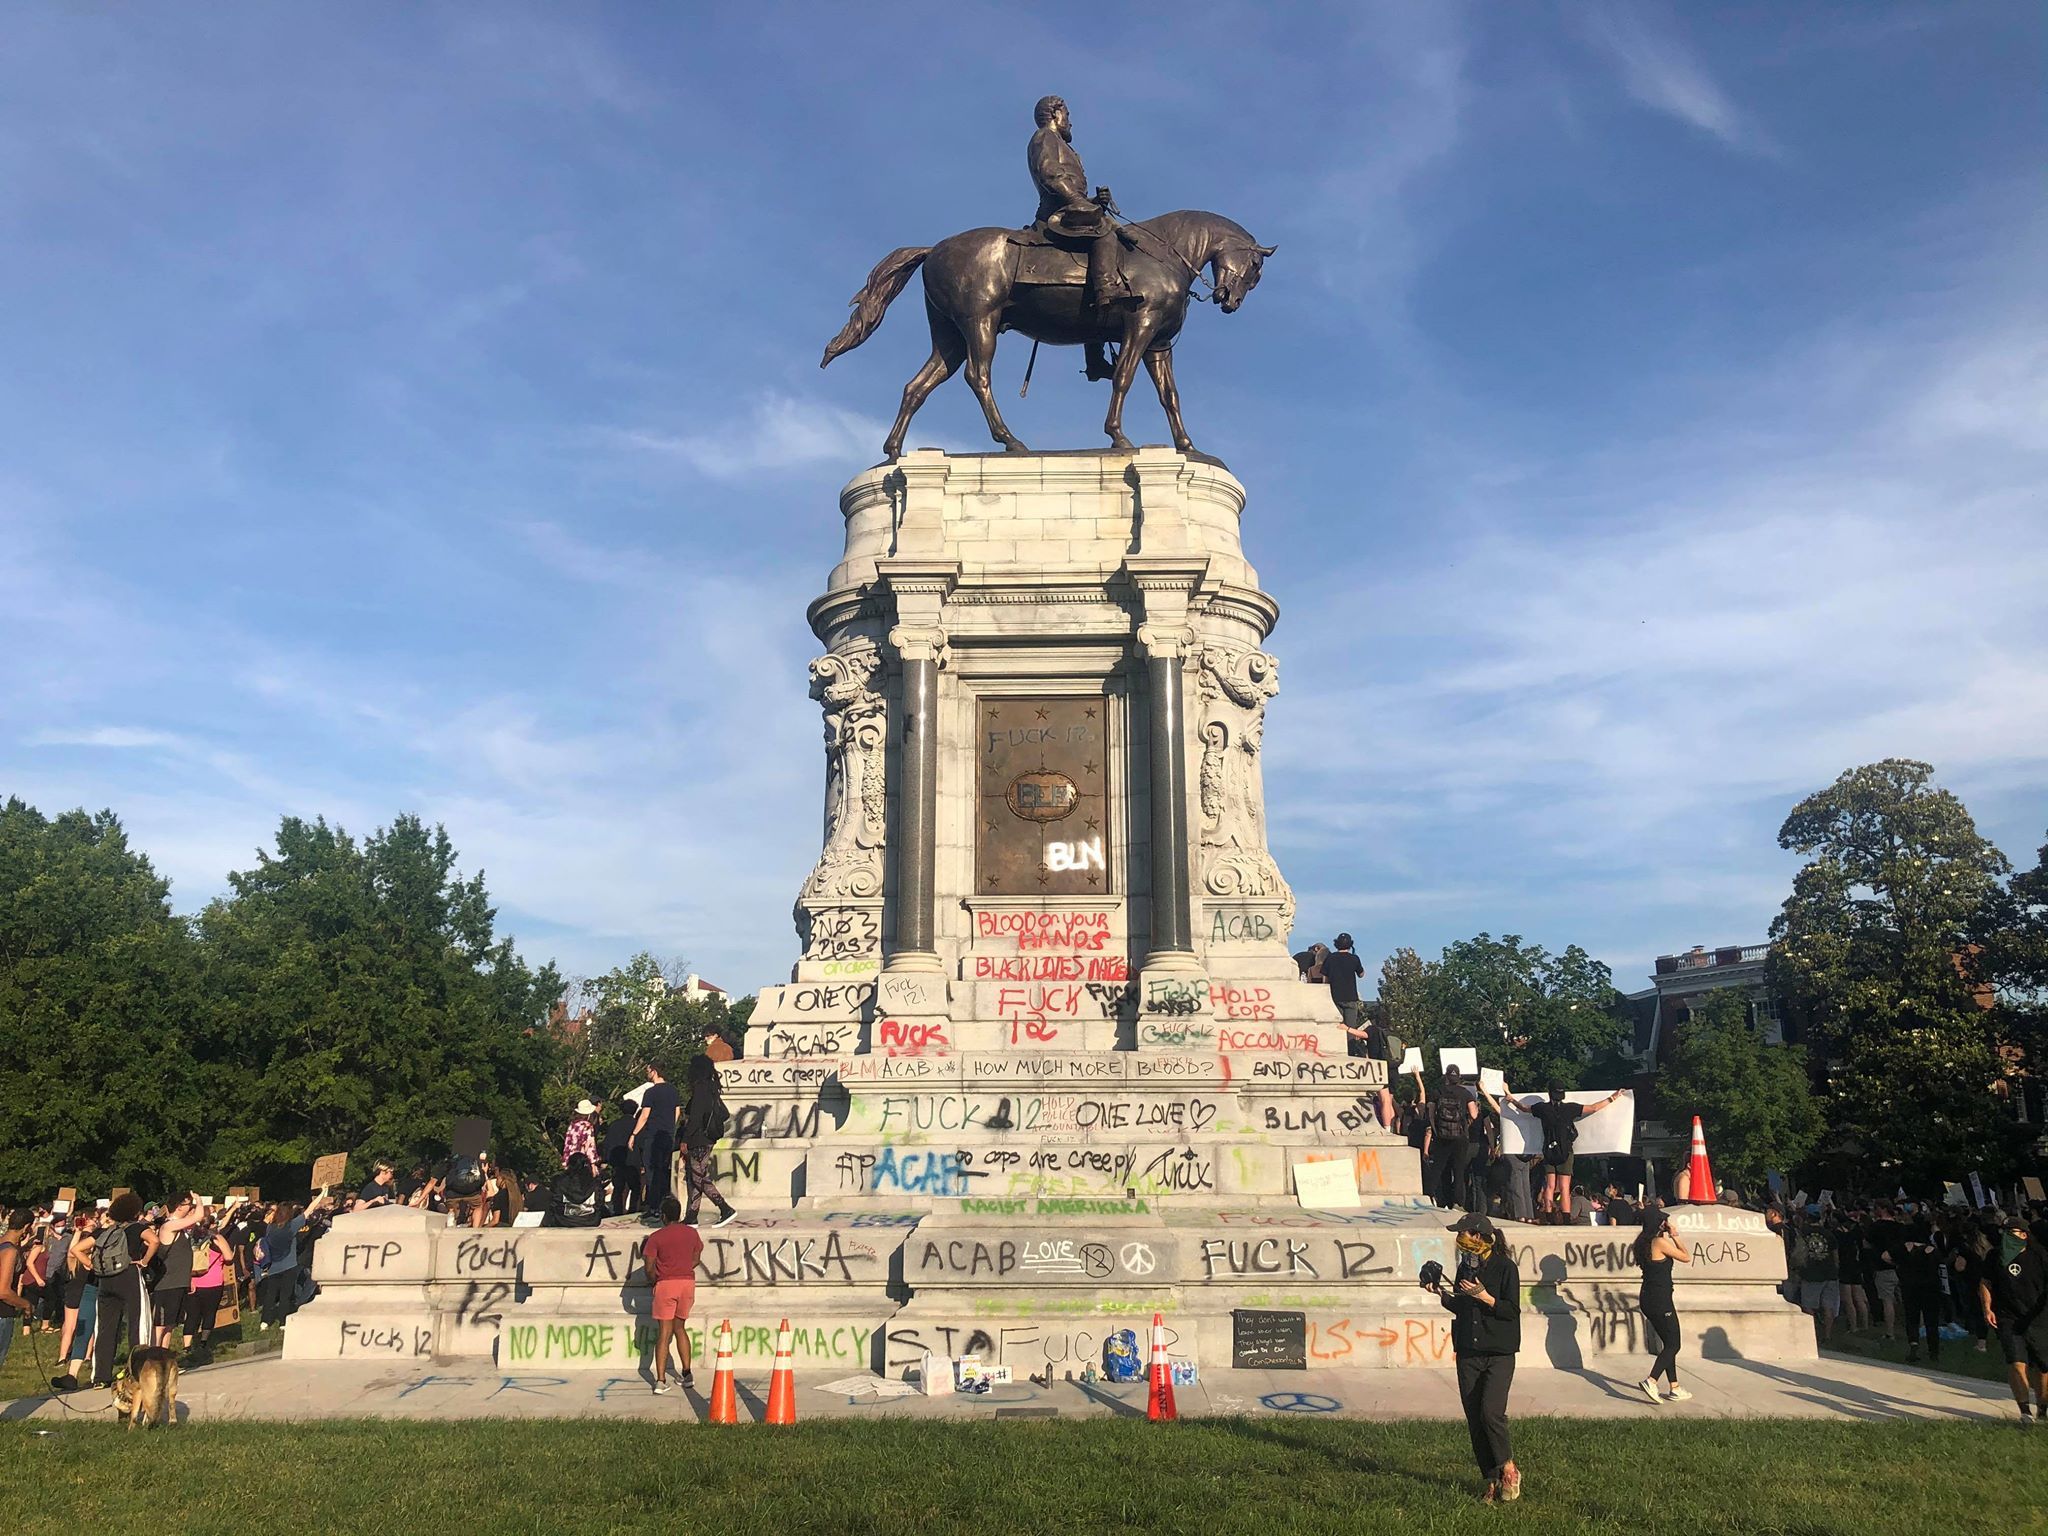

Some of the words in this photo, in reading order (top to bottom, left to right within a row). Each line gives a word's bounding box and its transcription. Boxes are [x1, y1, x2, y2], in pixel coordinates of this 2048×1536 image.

[988, 727, 1056, 753] FUCK
[978, 911, 1036, 937] BLOOD
[1211, 909, 1274, 944] ACAB
[1018, 930, 1111, 951] HANDS
[793, 985, 846, 1012] ONE
[998, 984, 1083, 1016] FUCK
[1209, 985, 1271, 1007] HOLD
[1011, 1010, 1058, 1045] 12
[748, 1069, 774, 1084] are
[839, 1060, 877, 1080] BLM
[883, 1057, 931, 1079] ACAB
[974, 1060, 1008, 1076] HOW
[1015, 1058, 1063, 1076] MUCH
[1070, 1059, 1122, 1076] MORE
[1137, 1060, 1214, 1076] BLOOD?
[1253, 1061, 1291, 1077] END
[1296, 1060, 1383, 1083] RACISM!
[879, 1096, 988, 1131] FUCK
[1016, 1097, 1052, 1130] 12
[1041, 1096, 1075, 1110] HOLD
[1076, 1101, 1131, 1129] ONE
[1136, 1102, 1186, 1126] LOVE
[1265, 1106, 1327, 1131] BLM
[1029, 1149, 1061, 1171] are
[342, 1241, 402, 1275] FTP
[922, 1240, 1017, 1276] ACAB
[1022, 1240, 1075, 1260] LOVE
[1201, 1238, 1319, 1279] FUCK
[1691, 1241, 1751, 1267] ACAB
[456, 1280, 511, 1329] 12
[414, 1325, 432, 1356] 12
[510, 1325, 537, 1360] NO
[545, 1323, 614, 1359] MORE
